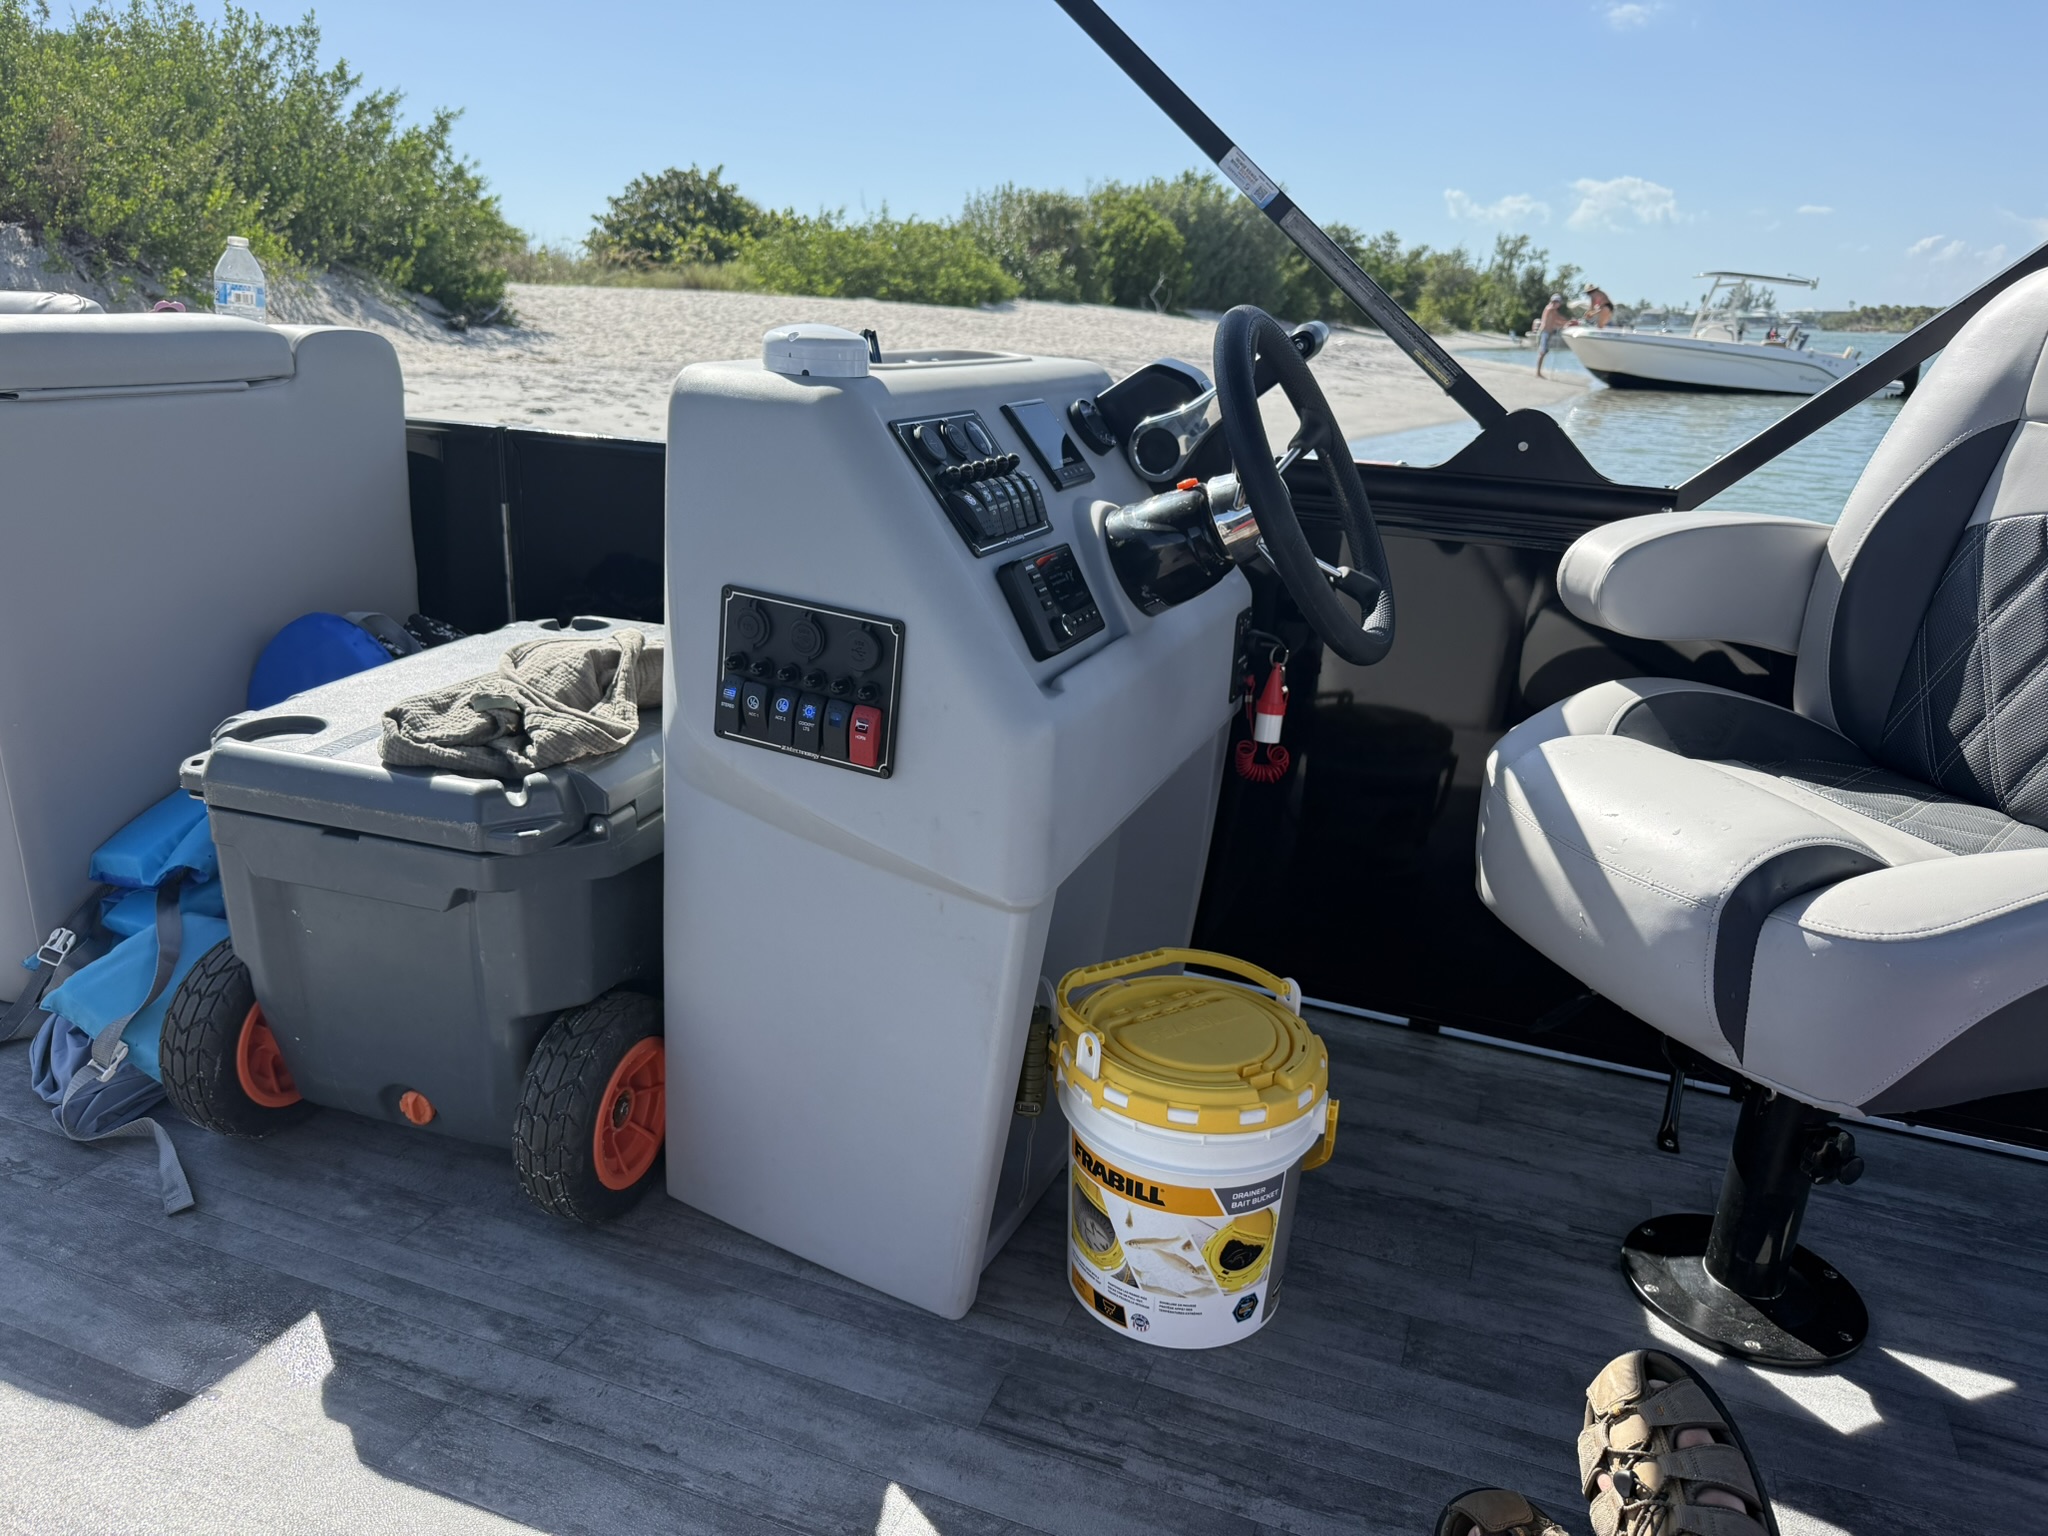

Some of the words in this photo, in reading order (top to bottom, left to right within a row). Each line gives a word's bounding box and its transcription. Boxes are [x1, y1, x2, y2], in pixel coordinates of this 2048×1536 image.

[721, 701, 735, 709] STEREO
[1074, 1138, 1166, 1206] FRABILL
[1231, 1199, 1250, 1209] BAIT
[1251, 1190, 1279, 1206] BUCKET
[1232, 1187, 1266, 1200] DRAINER
